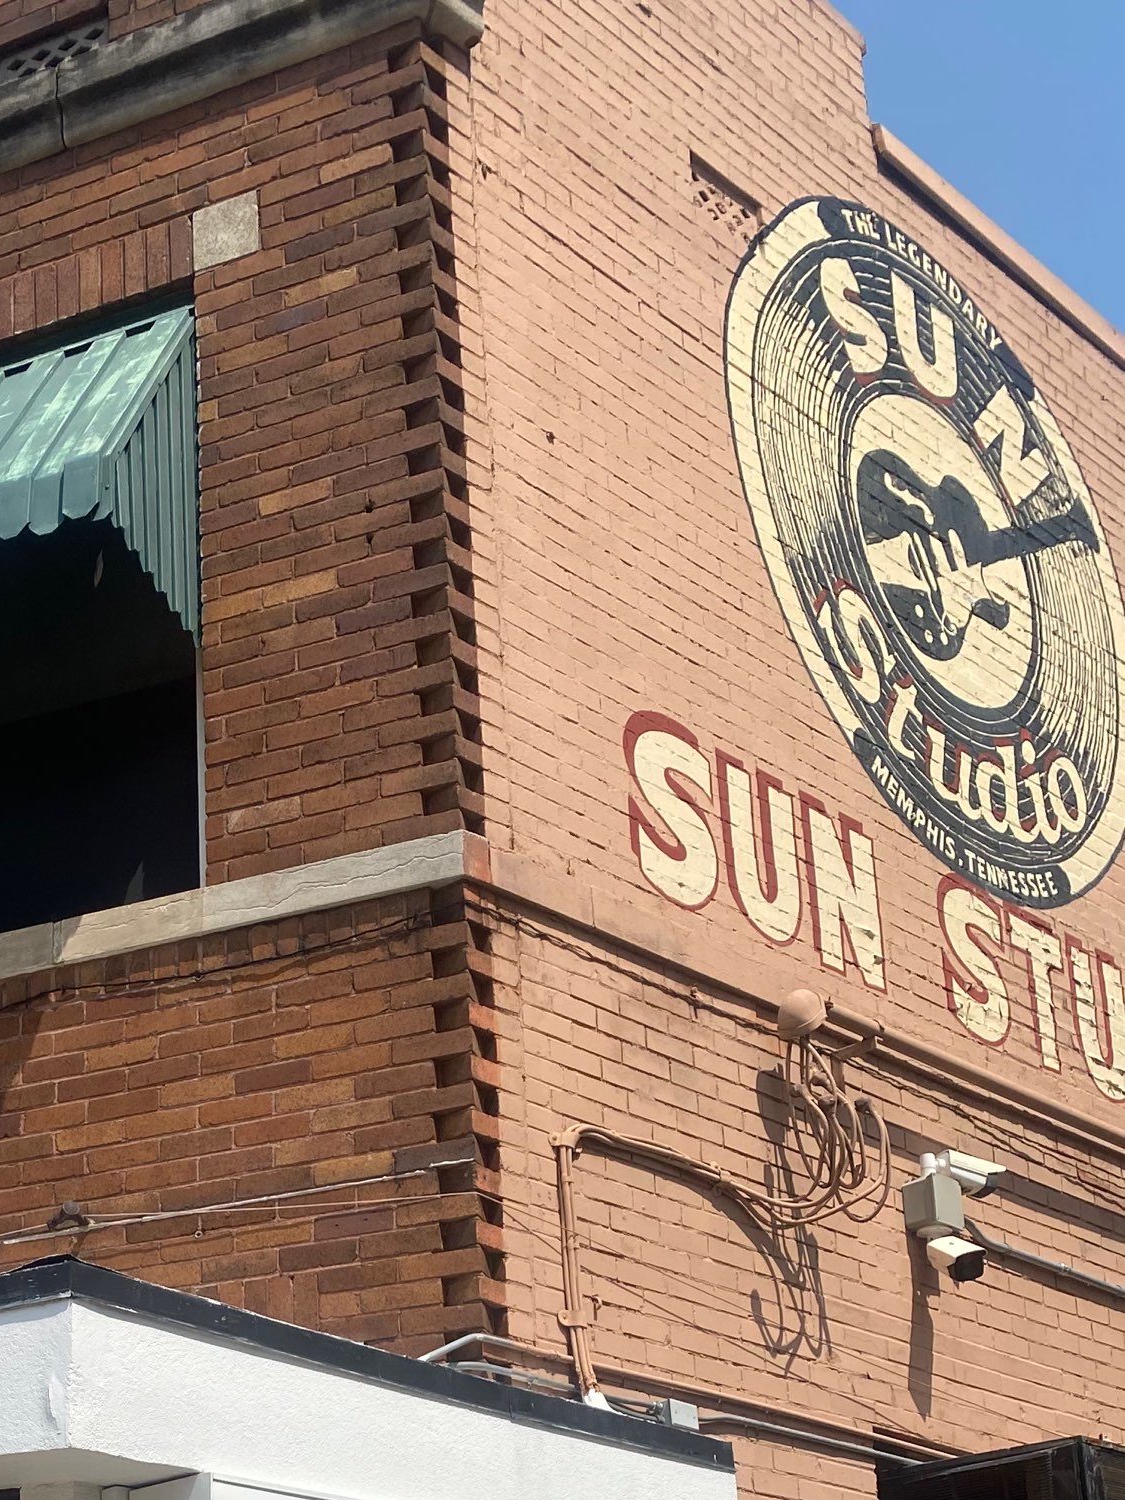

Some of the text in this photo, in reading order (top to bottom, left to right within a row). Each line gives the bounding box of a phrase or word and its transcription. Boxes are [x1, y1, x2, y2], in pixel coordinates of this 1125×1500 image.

[819, 256, 1054, 505] SUN
[841, 207, 1003, 351] THE LEGENDARY
[815, 580, 1088, 845] Studio
[623, 710, 887, 994] SUN
[965, 849, 1059, 898] TENNESSEE
